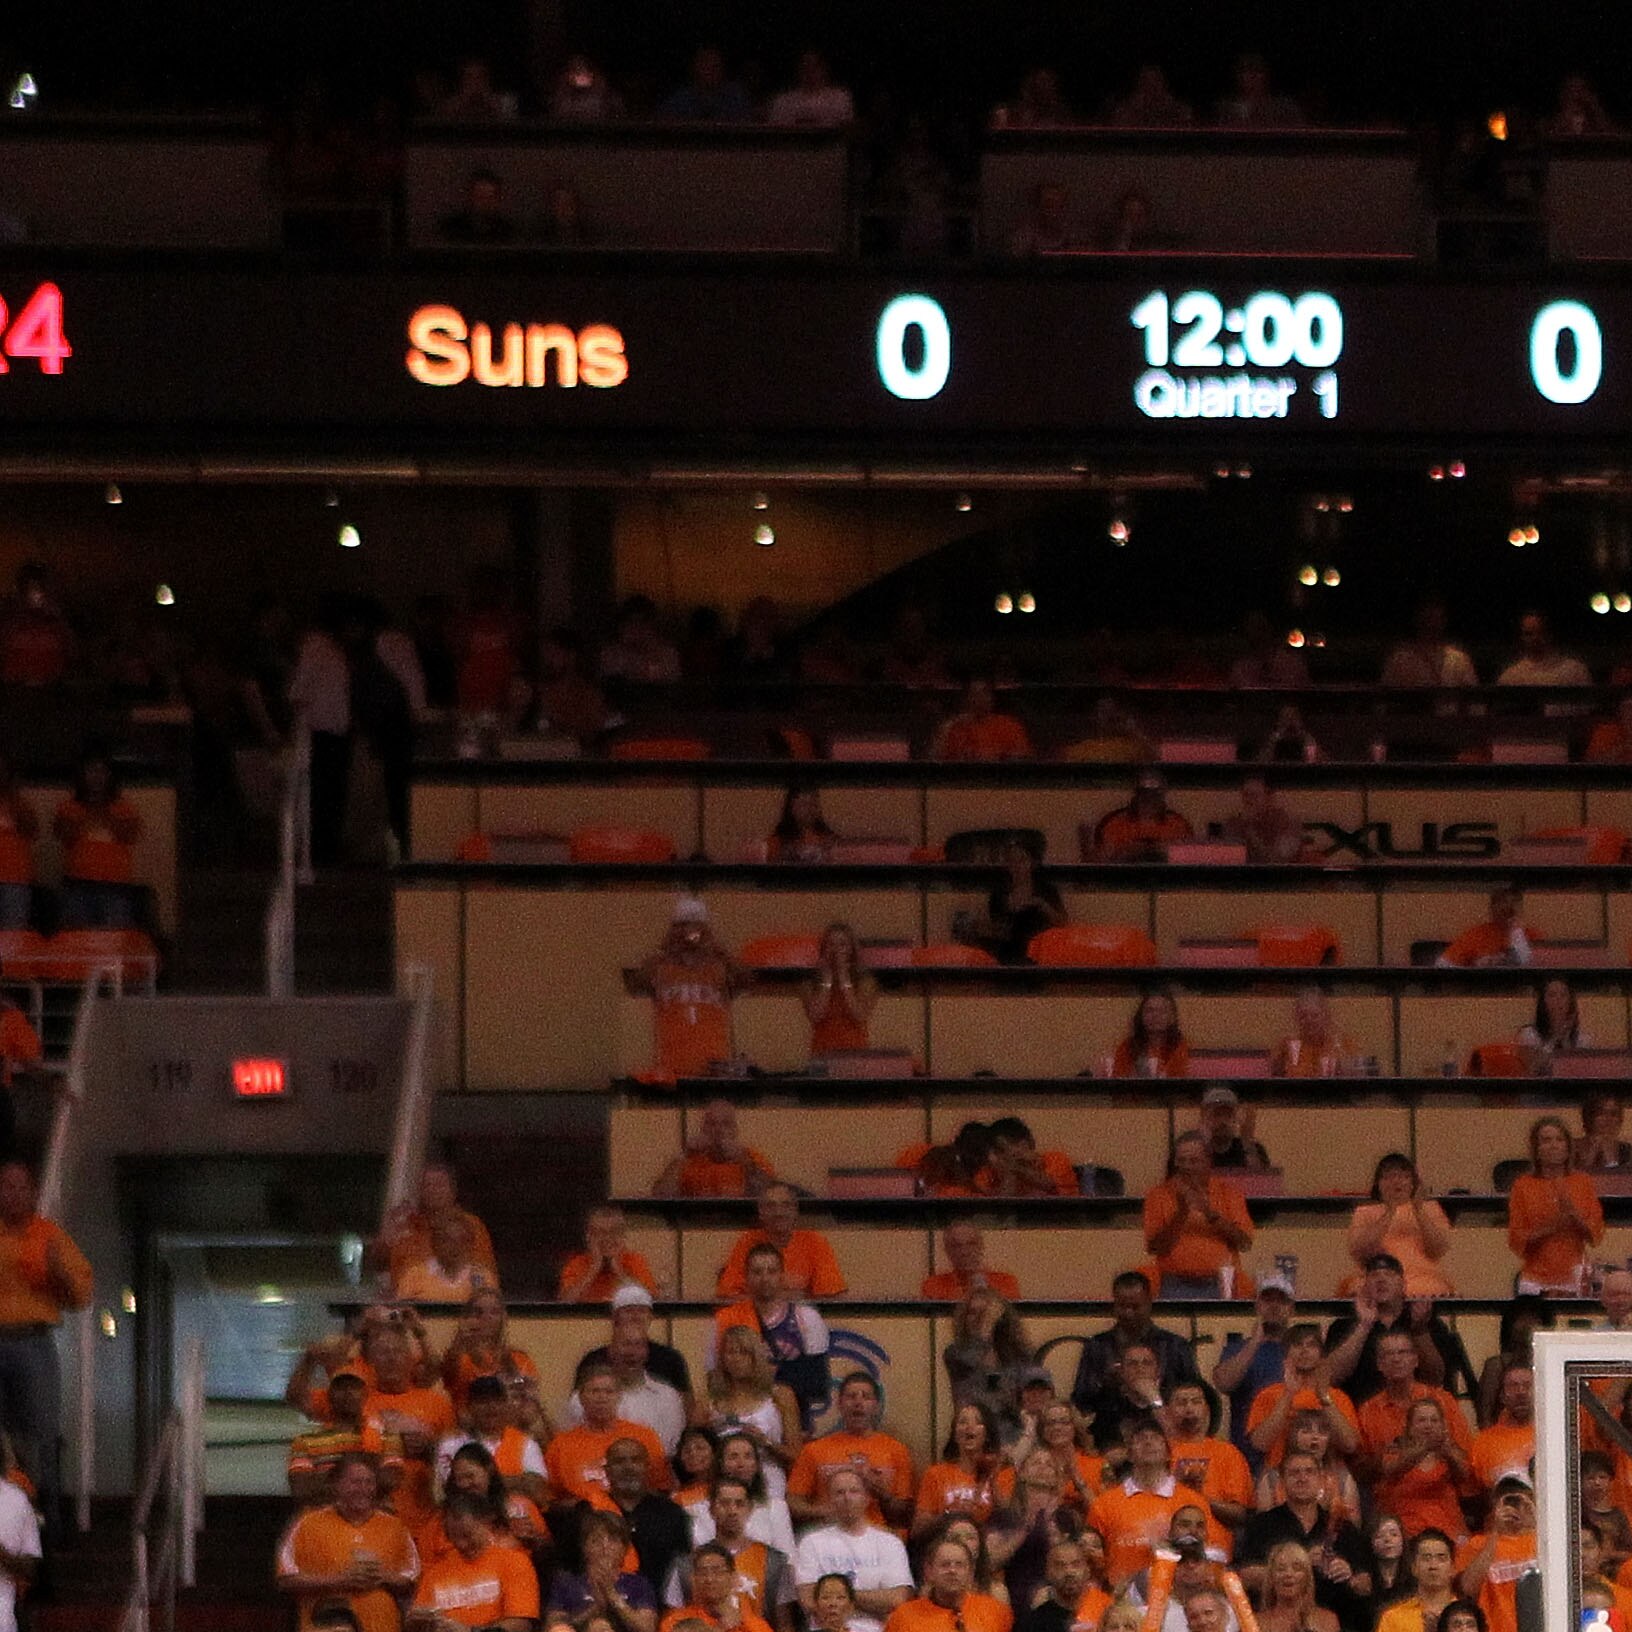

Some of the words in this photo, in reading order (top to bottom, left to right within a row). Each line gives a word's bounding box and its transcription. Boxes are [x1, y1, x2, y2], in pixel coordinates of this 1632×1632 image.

[0, 281, 72, 374] 4
[404, 303, 628, 388] Suns
[877, 293, 952, 400] 0
[1130, 292, 1343, 367] 12:00
[1530, 299, 1603, 404] 0
[1133, 370, 1306, 418] Quarter
[1320, 371, 1339, 418] 1
